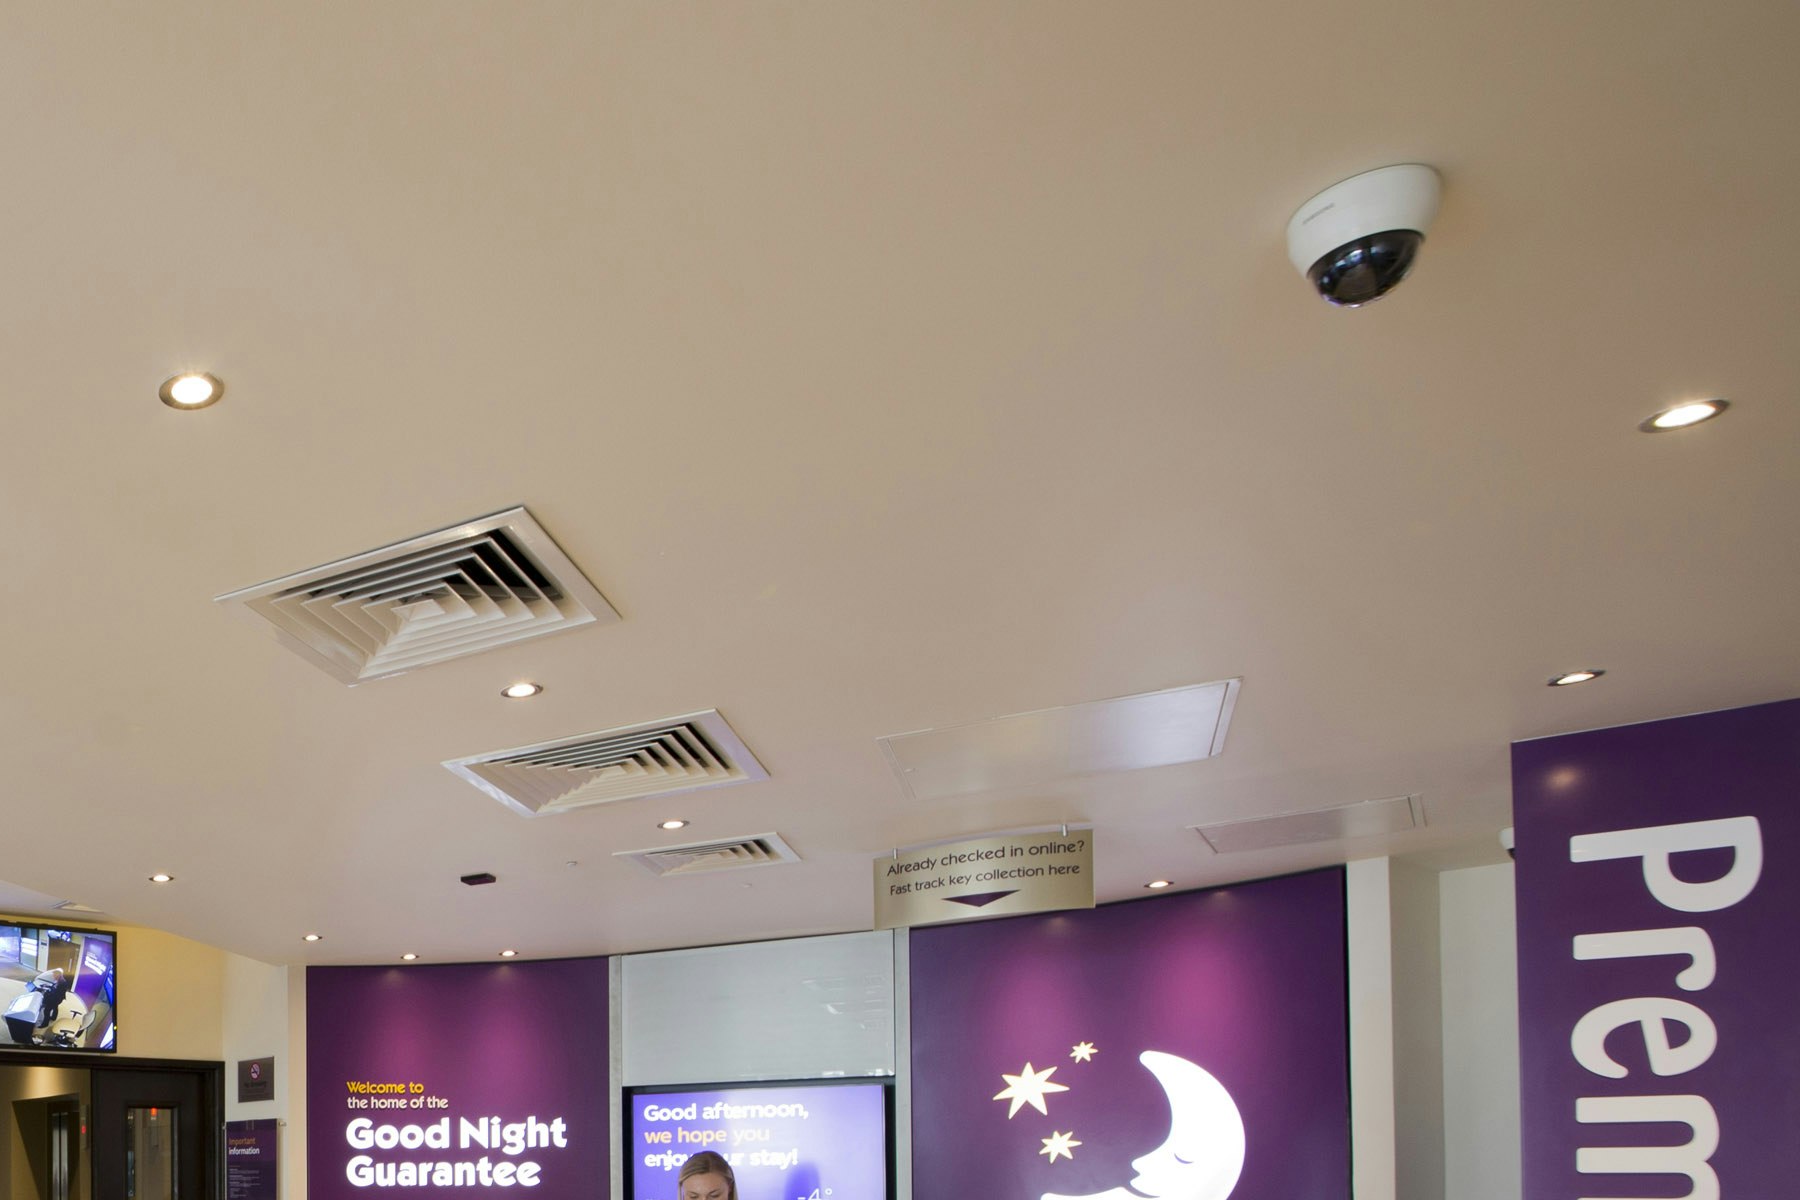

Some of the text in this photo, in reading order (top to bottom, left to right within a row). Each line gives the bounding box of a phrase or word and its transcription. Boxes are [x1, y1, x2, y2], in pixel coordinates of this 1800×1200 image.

[886, 840, 1085, 877] Already checked in online?
[890, 864, 1080, 896] Fast track key collection here
[346, 1081, 424, 1094] Welcome to
[347, 1095, 449, 1109] the home of the
[643, 1101, 809, 1122] Good afternoon,
[346, 1115, 568, 1155] Good Night
[643, 1127, 771, 1146] we hope you
[749, 1149, 799, 1170] stay!
[346, 1155, 542, 1187] Guarantee
